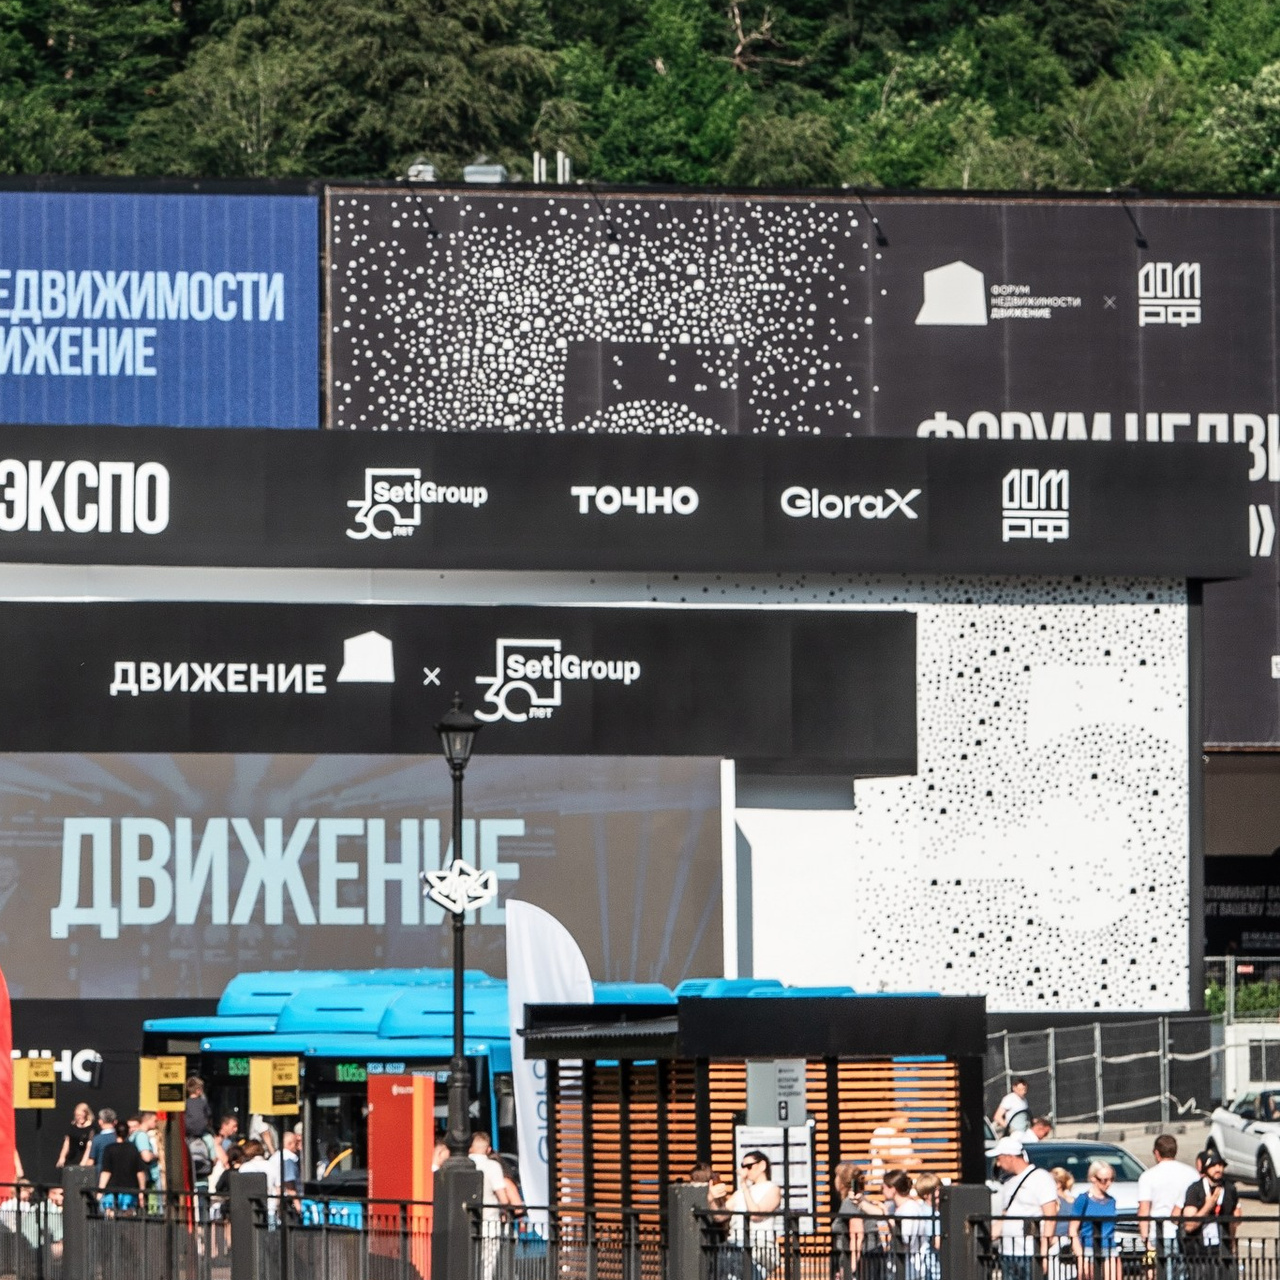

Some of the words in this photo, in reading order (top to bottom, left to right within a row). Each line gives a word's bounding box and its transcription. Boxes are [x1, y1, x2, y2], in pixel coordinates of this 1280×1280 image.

[570, 485, 700, 515] ТОЧНО
[780, 485, 922, 520] GloraX
[109, 661, 327, 697] ДВИЖЕНИЕ
[50, 817, 525, 940] ДВИЖЕНИЕ
